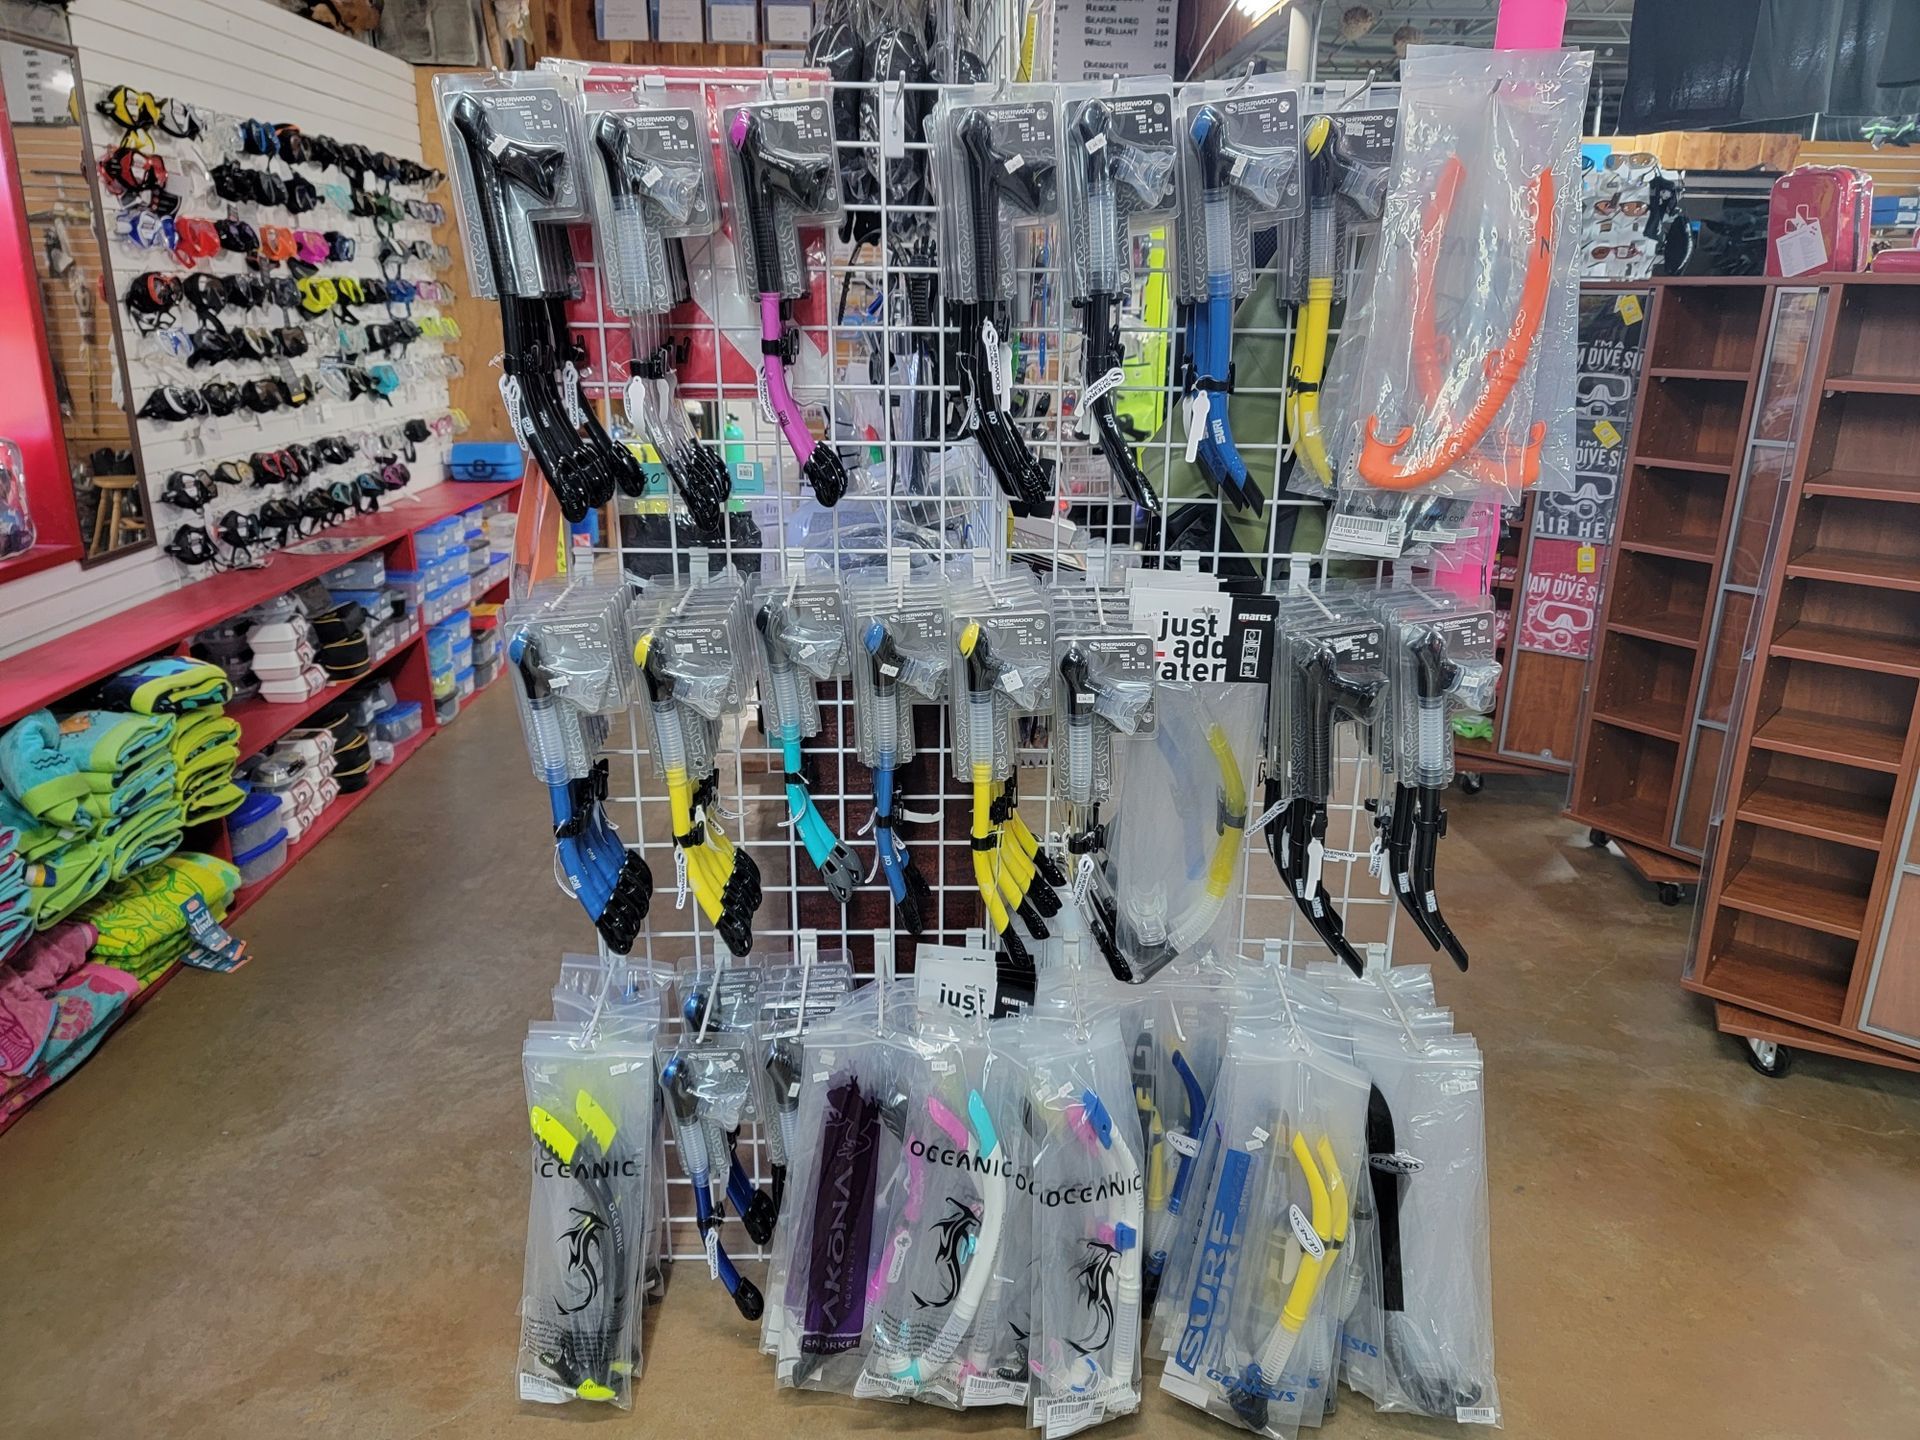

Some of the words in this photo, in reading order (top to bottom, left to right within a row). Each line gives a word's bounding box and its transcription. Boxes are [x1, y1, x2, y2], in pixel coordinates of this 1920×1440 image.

[1237, 98, 1278, 107] SHERWOOD
[1614, 341, 1625, 349] A
[1587, 347, 1622, 367] DIVE
[992, 344, 1001, 391] SHERWOOD
[1575, 448, 1607, 466] DIVE
[1536, 510, 1569, 535] AIR
[1552, 579, 1586, 599] DIVE
[1578, 576, 1588, 584] A
[1157, 611, 1218, 641] just
[1238, 613, 1272, 621] mares
[1155, 659, 1227, 681] ater
[534, 1160, 636, 1179] CEANIC
[910, 1141, 1013, 1178] OCEANIC
[1371, 1157, 1420, 1169] GENESIS
[1046, 1174, 1142, 1208] OCEANIC
[608, 1202, 624, 1254] OCEANIC
[1180, 1209, 1229, 1370] SURF
